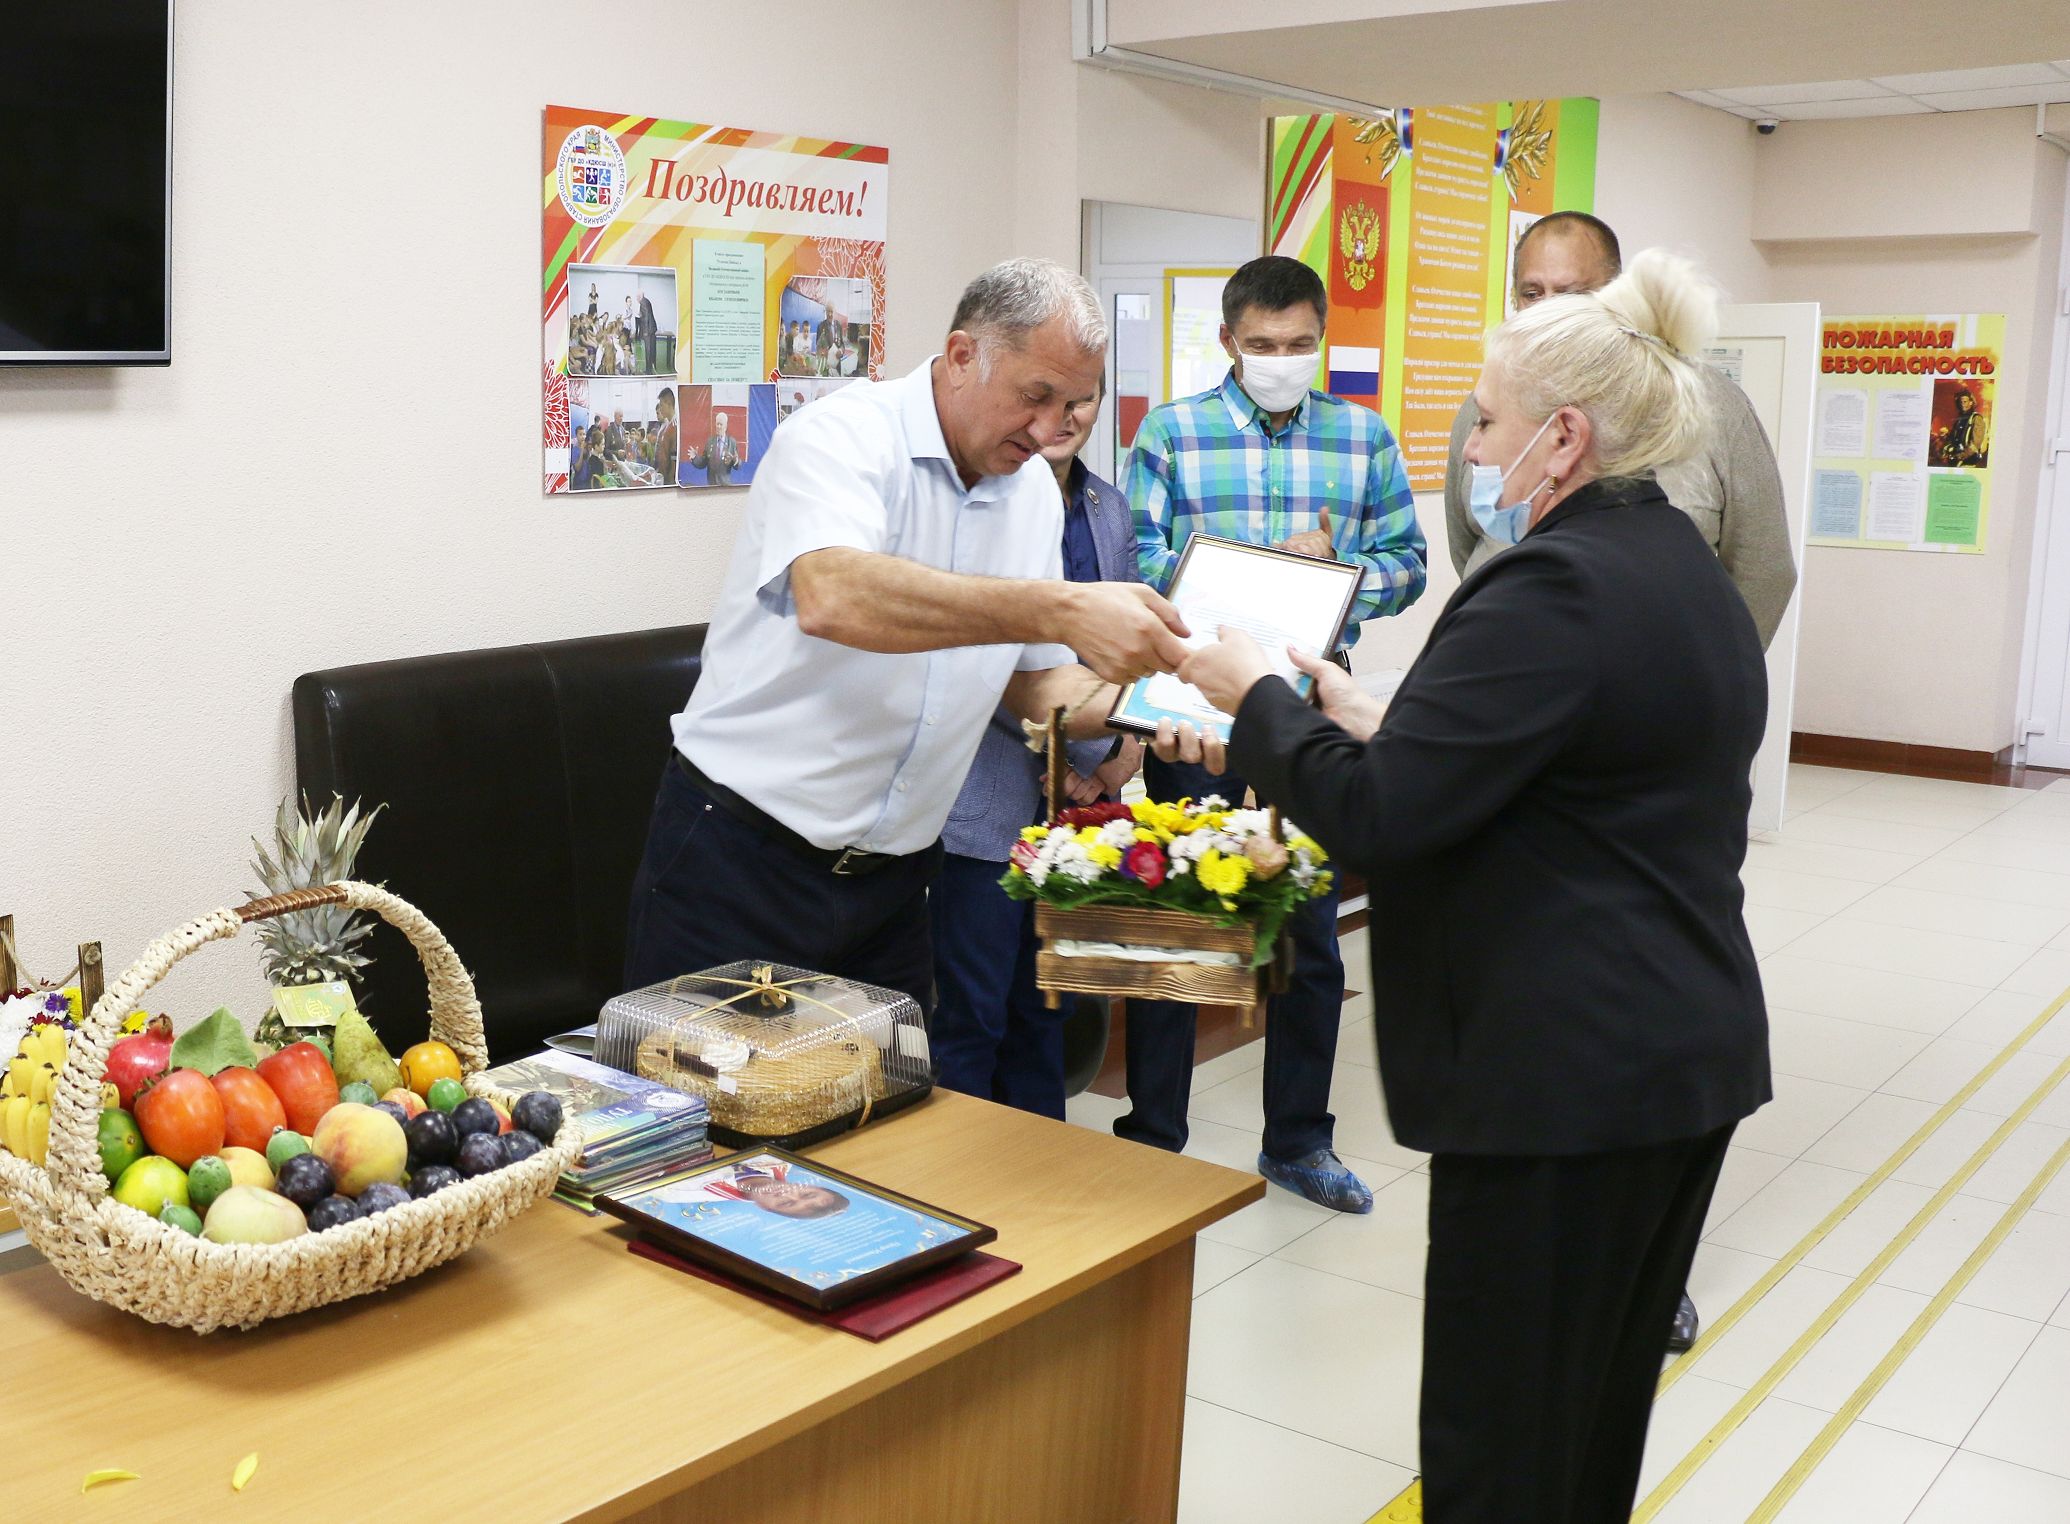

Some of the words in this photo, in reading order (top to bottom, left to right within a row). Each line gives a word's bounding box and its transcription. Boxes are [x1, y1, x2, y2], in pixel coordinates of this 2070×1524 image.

[642, 158, 868, 217] Поздравляем!
[1823, 330, 1955, 349] ПОЖАРНАЯ
[1821, 355, 1995, 376] БЕЗОПАСНОСТЬ
